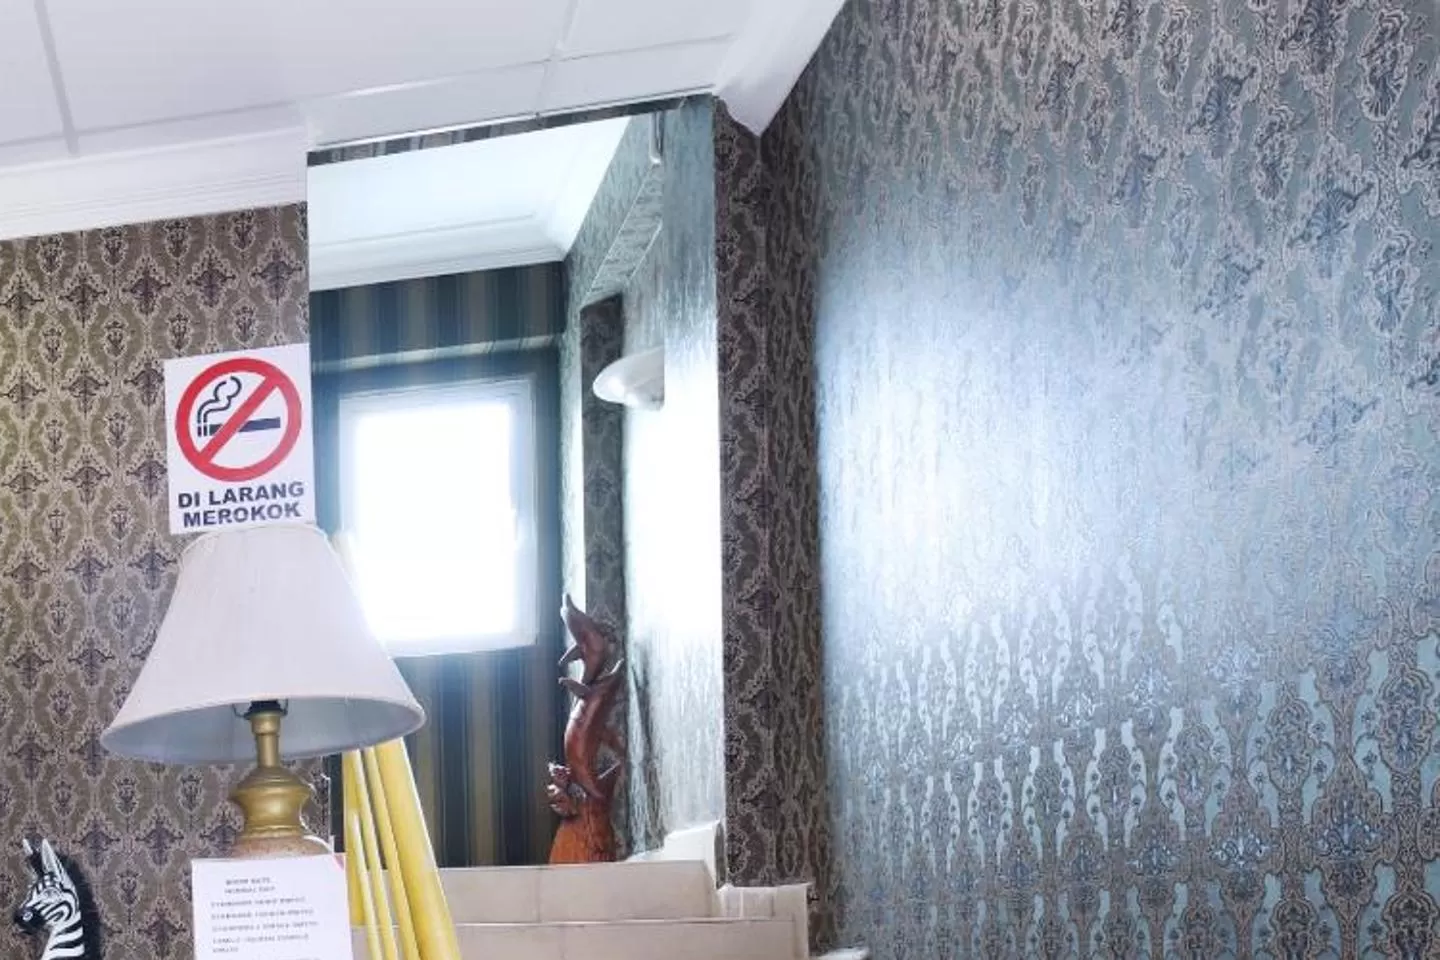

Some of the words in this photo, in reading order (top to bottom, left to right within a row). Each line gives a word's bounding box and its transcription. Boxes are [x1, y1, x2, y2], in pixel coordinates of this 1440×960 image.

[178, 492, 200, 508] DI
[208, 481, 305, 506] LARANG
[184, 502, 302, 527] MEROKOK
